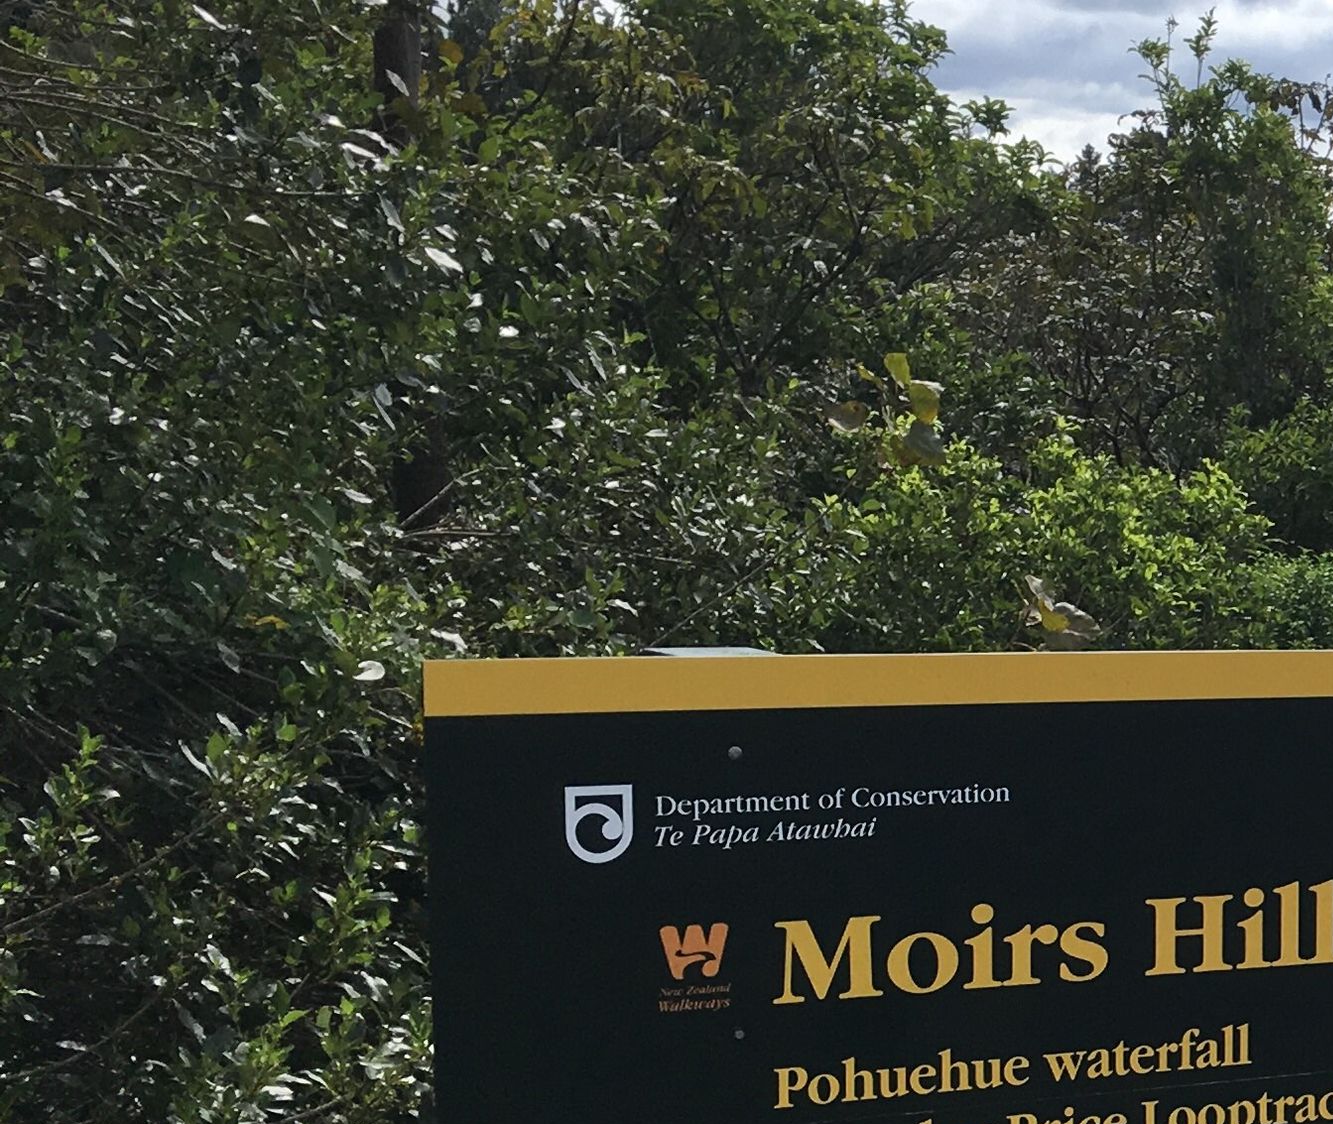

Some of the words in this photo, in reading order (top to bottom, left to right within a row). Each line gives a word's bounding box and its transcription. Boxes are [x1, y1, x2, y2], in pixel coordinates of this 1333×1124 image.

[656, 791, 809, 823] Department
[818, 787, 847, 810] of
[851, 783, 1010, 808] Conservation
[655, 825, 683, 847] Te
[692, 823, 758, 850] Papa
[768, 817, 876, 842] Atawhai
[773, 903, 1109, 1005] Moirs
[659, 998, 731, 1012] Walkways
[686, 983, 732, 996] Zealand
[774, 1049, 1029, 1109] Pohuehue
[1043, 1023, 1252, 1083] waterfall
